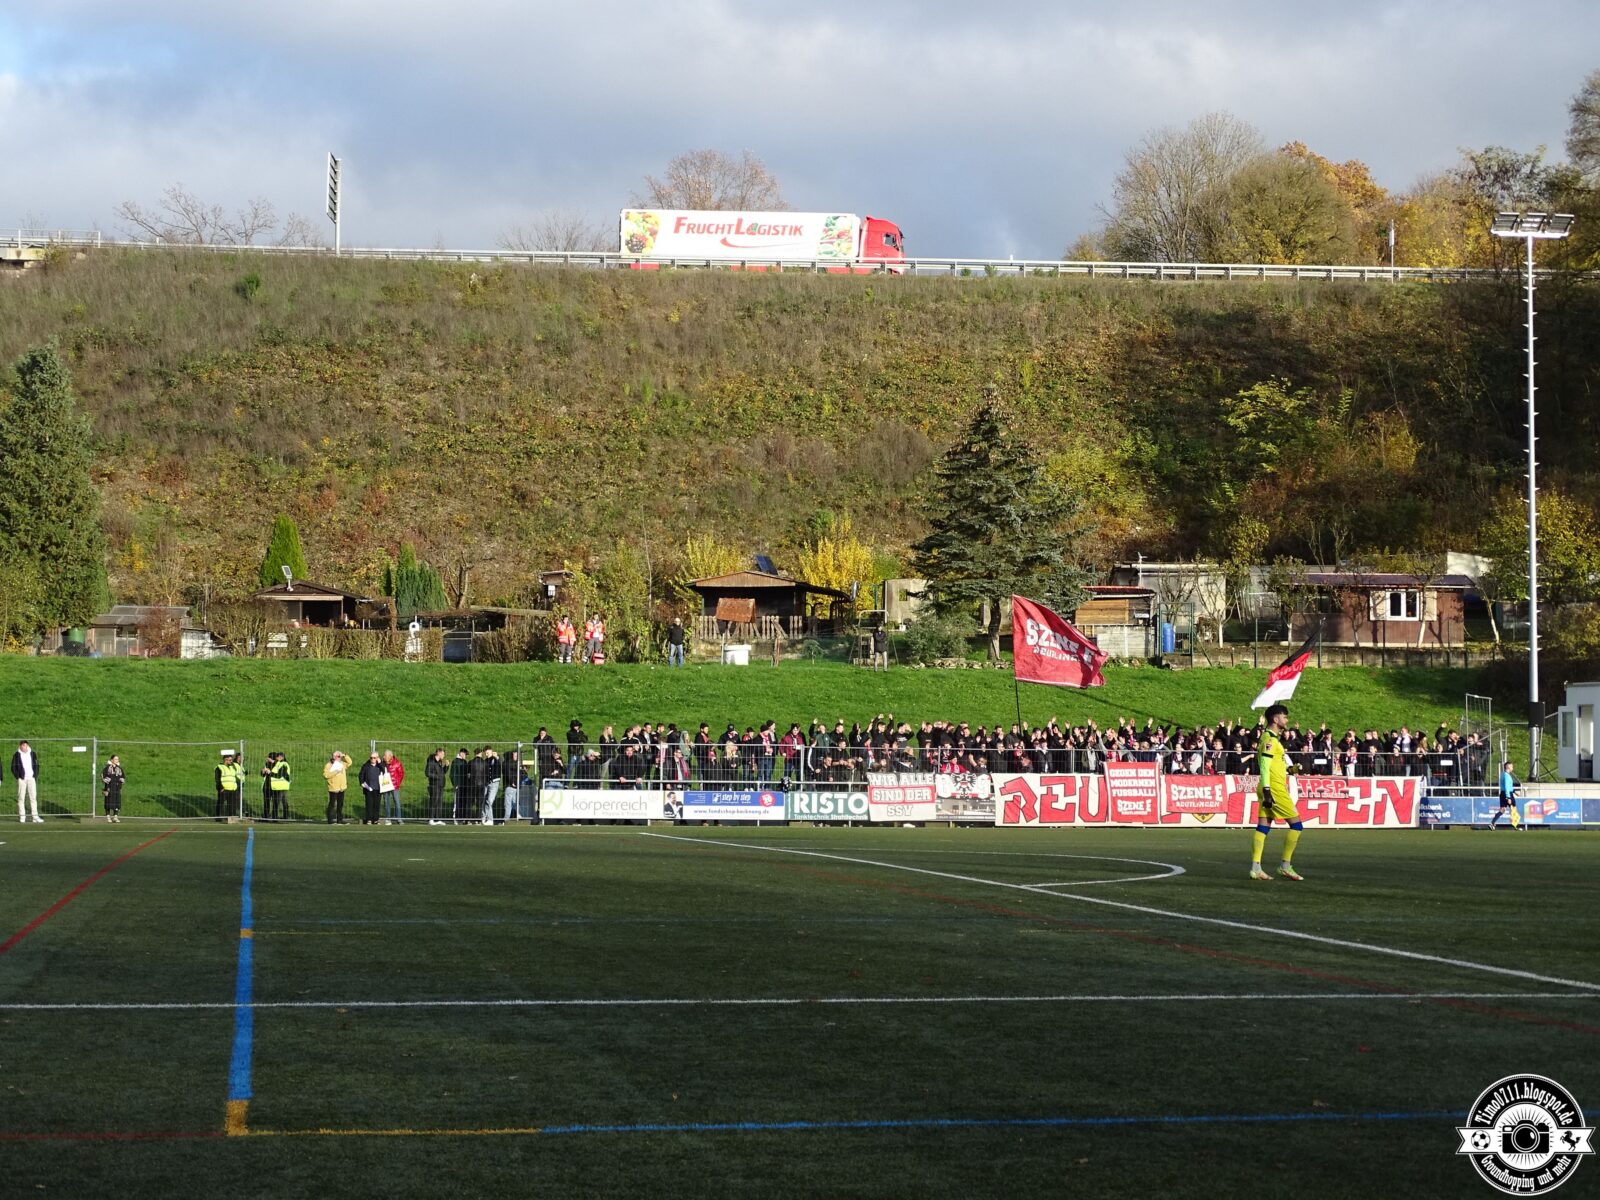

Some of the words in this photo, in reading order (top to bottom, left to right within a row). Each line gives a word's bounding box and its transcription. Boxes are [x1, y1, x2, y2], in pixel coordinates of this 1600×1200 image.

[868, 773, 898, 786] WIR
[899, 773, 934, 786] ALLE
[872, 788, 904, 802] SIND
[904, 787, 932, 801] DER
[1171, 784, 1213, 801] SZENE
[1214, 784, 1223, 802] E
[793, 793, 868, 815] RISTO
[887, 805, 913, 816] SSV
[1117, 800, 1144, 812] SZENE
